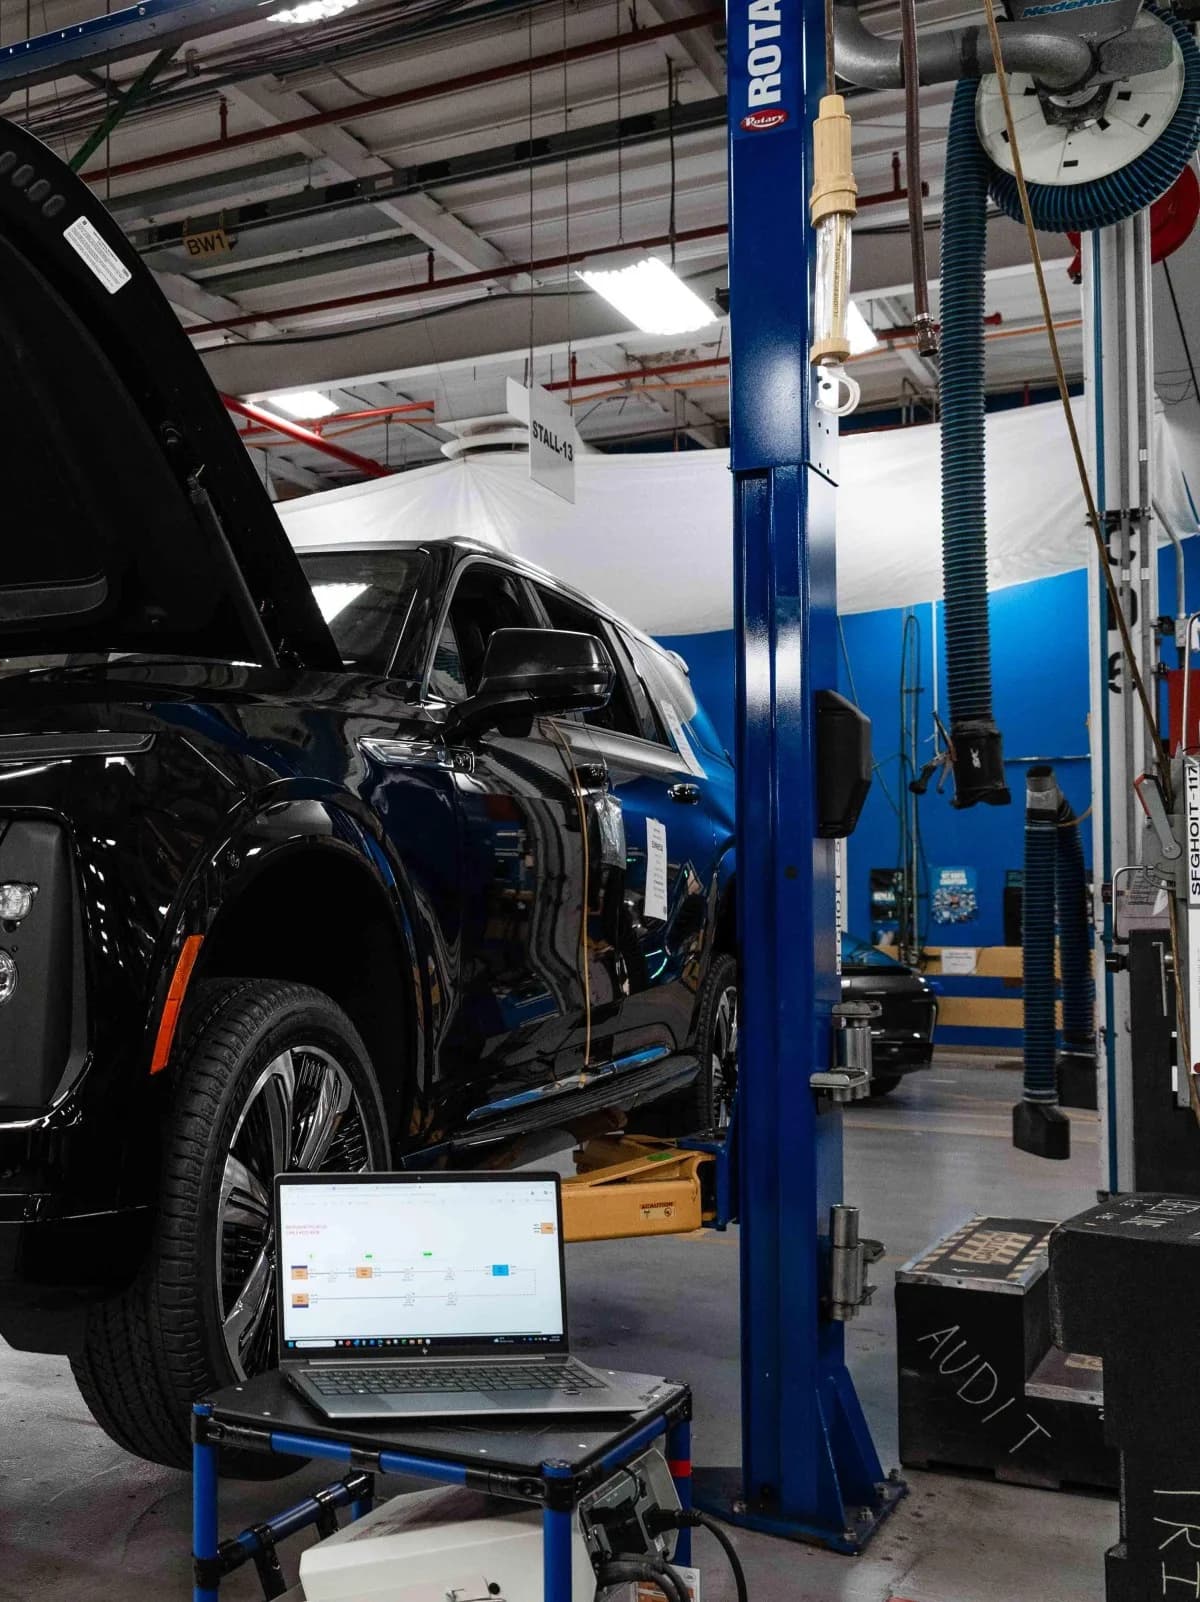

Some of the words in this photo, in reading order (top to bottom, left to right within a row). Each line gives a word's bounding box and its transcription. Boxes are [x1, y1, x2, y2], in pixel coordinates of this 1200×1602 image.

[743, 112, 785, 128] Rotary
[186, 233, 225, 256] BW1
[532, 420, 574, 461] STALL-13
[917, 1325, 1052, 1454] AUDIT
